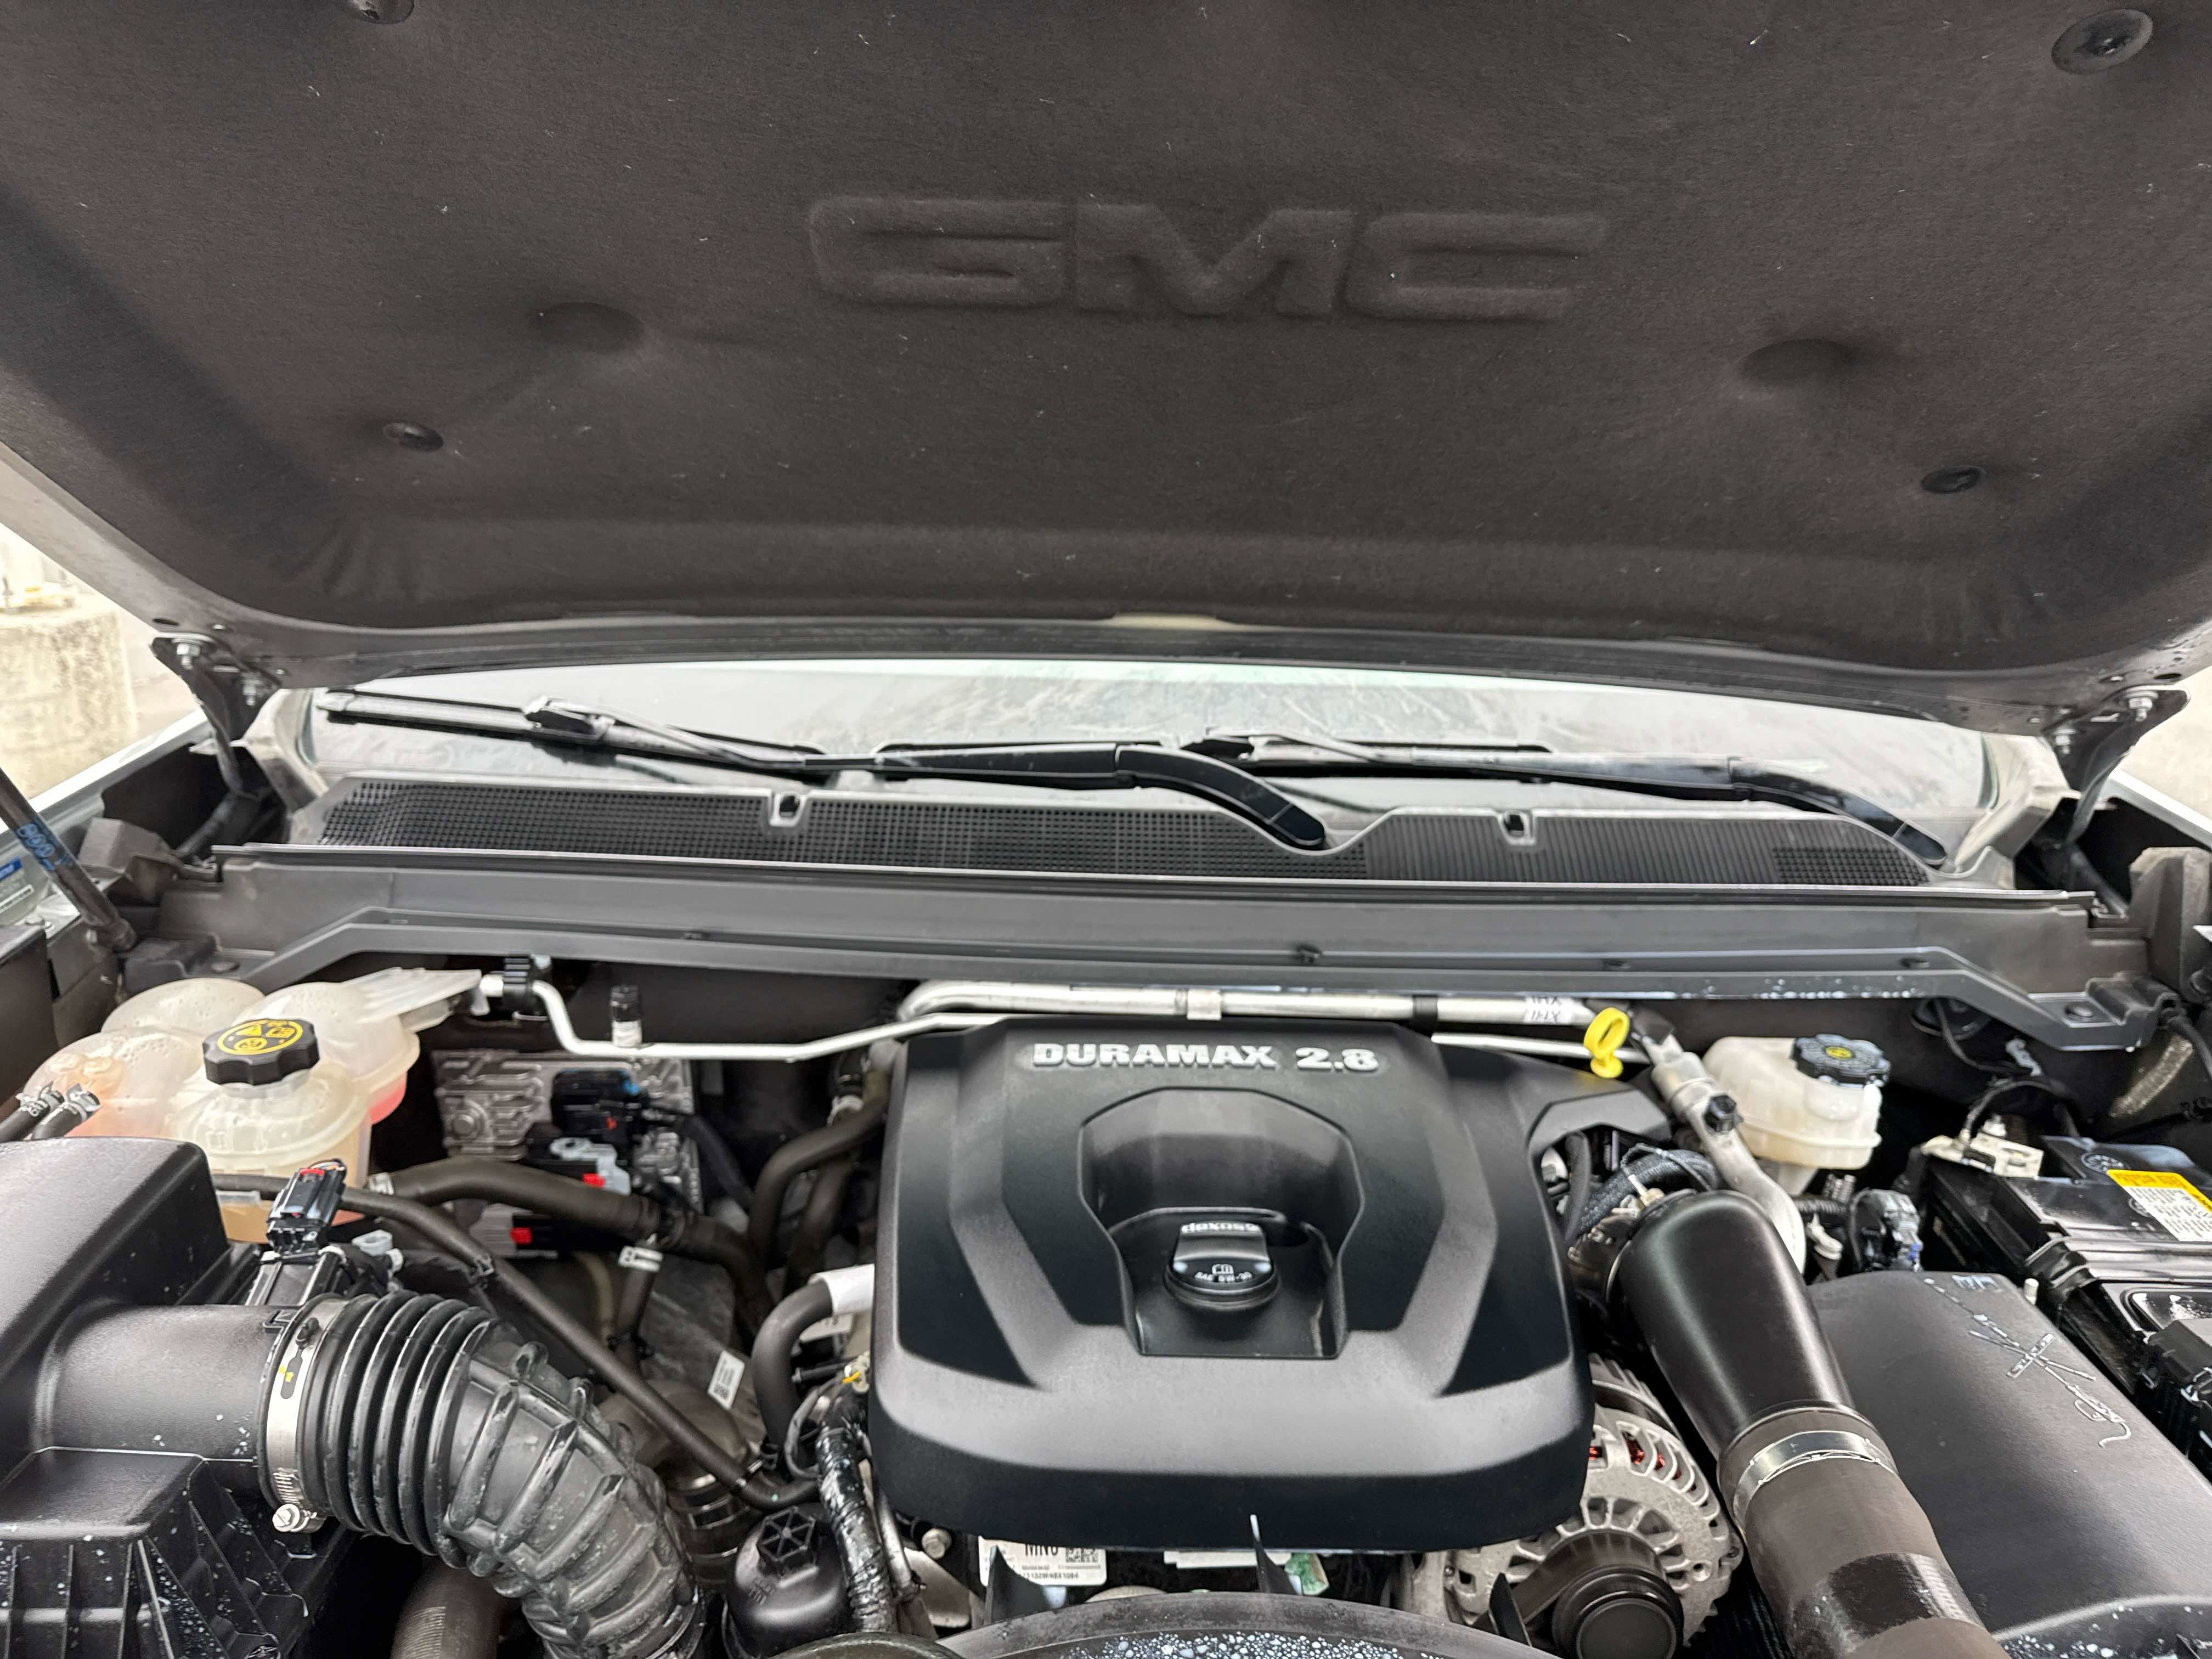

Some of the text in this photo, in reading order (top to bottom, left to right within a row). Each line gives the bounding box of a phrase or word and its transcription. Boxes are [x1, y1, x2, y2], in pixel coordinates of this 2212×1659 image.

[809, 196, 1606, 324] GMC
[1033, 1043, 1379, 1072] DURAMAX 2.8
